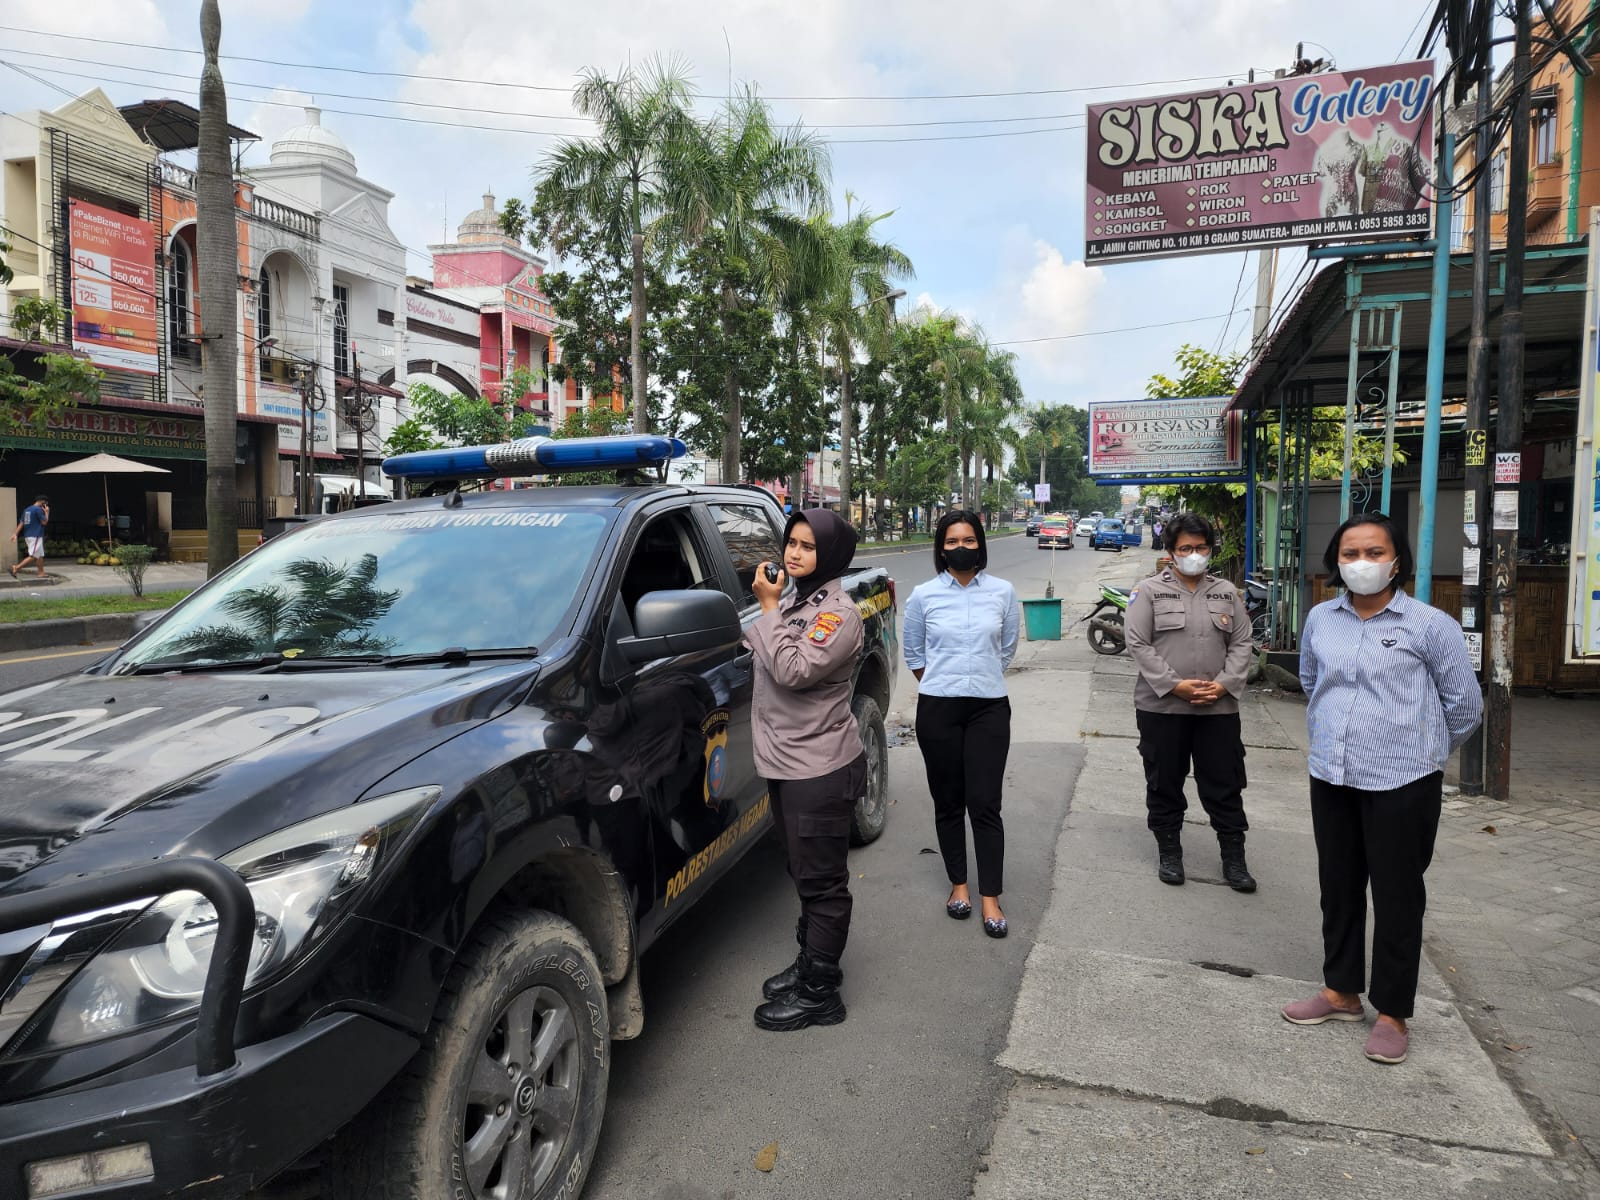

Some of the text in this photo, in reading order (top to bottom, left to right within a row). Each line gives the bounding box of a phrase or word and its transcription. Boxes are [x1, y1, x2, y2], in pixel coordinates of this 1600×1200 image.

[1098, 87, 1289, 167] SISKA
[1122, 165, 1192, 187] MENERIMA
[1195, 156, 1269, 179] TEMPAHAN
[1273, 172, 1318, 188] PAYET
[1200, 183, 1229, 196] ROK
[1273, 190, 1299, 204] DLL
[1105, 191, 1156, 205] KEBAYA
[1199, 197, 1245, 211] WIRON
[1105, 205, 1163, 220] KAMISOL
[1199, 212, 1250, 226] BORDIR
[1089, 244, 1100, 255] JL.
[1102, 242, 1126, 254] JAMIN
[1128, 239, 1160, 251] GINTING
[1162, 237, 1176, 248] NO.
[1178, 236, 1187, 247] 10
[1189, 235, 1202, 246] KM
[1204, 235, 1209, 245] 9
[1211, 231, 1240, 243] GRAND
[1292, 222, 1322, 236] MEDAN
[1359, 218, 1381, 230] 0853
[1383, 215, 1403, 228] 5858
[1406, 213, 1427, 226] 3836
[1105, 220, 1168, 235] SONGKET
[78, 255, 95, 271] 50
[79, 290, 97, 304] 125
[143, 438, 180, 449] SALON
[443, 512, 569, 528] TUNTUNGAN
[1206, 592, 1232, 600] POLRI
[664, 819, 739, 908] POLRESTABES
